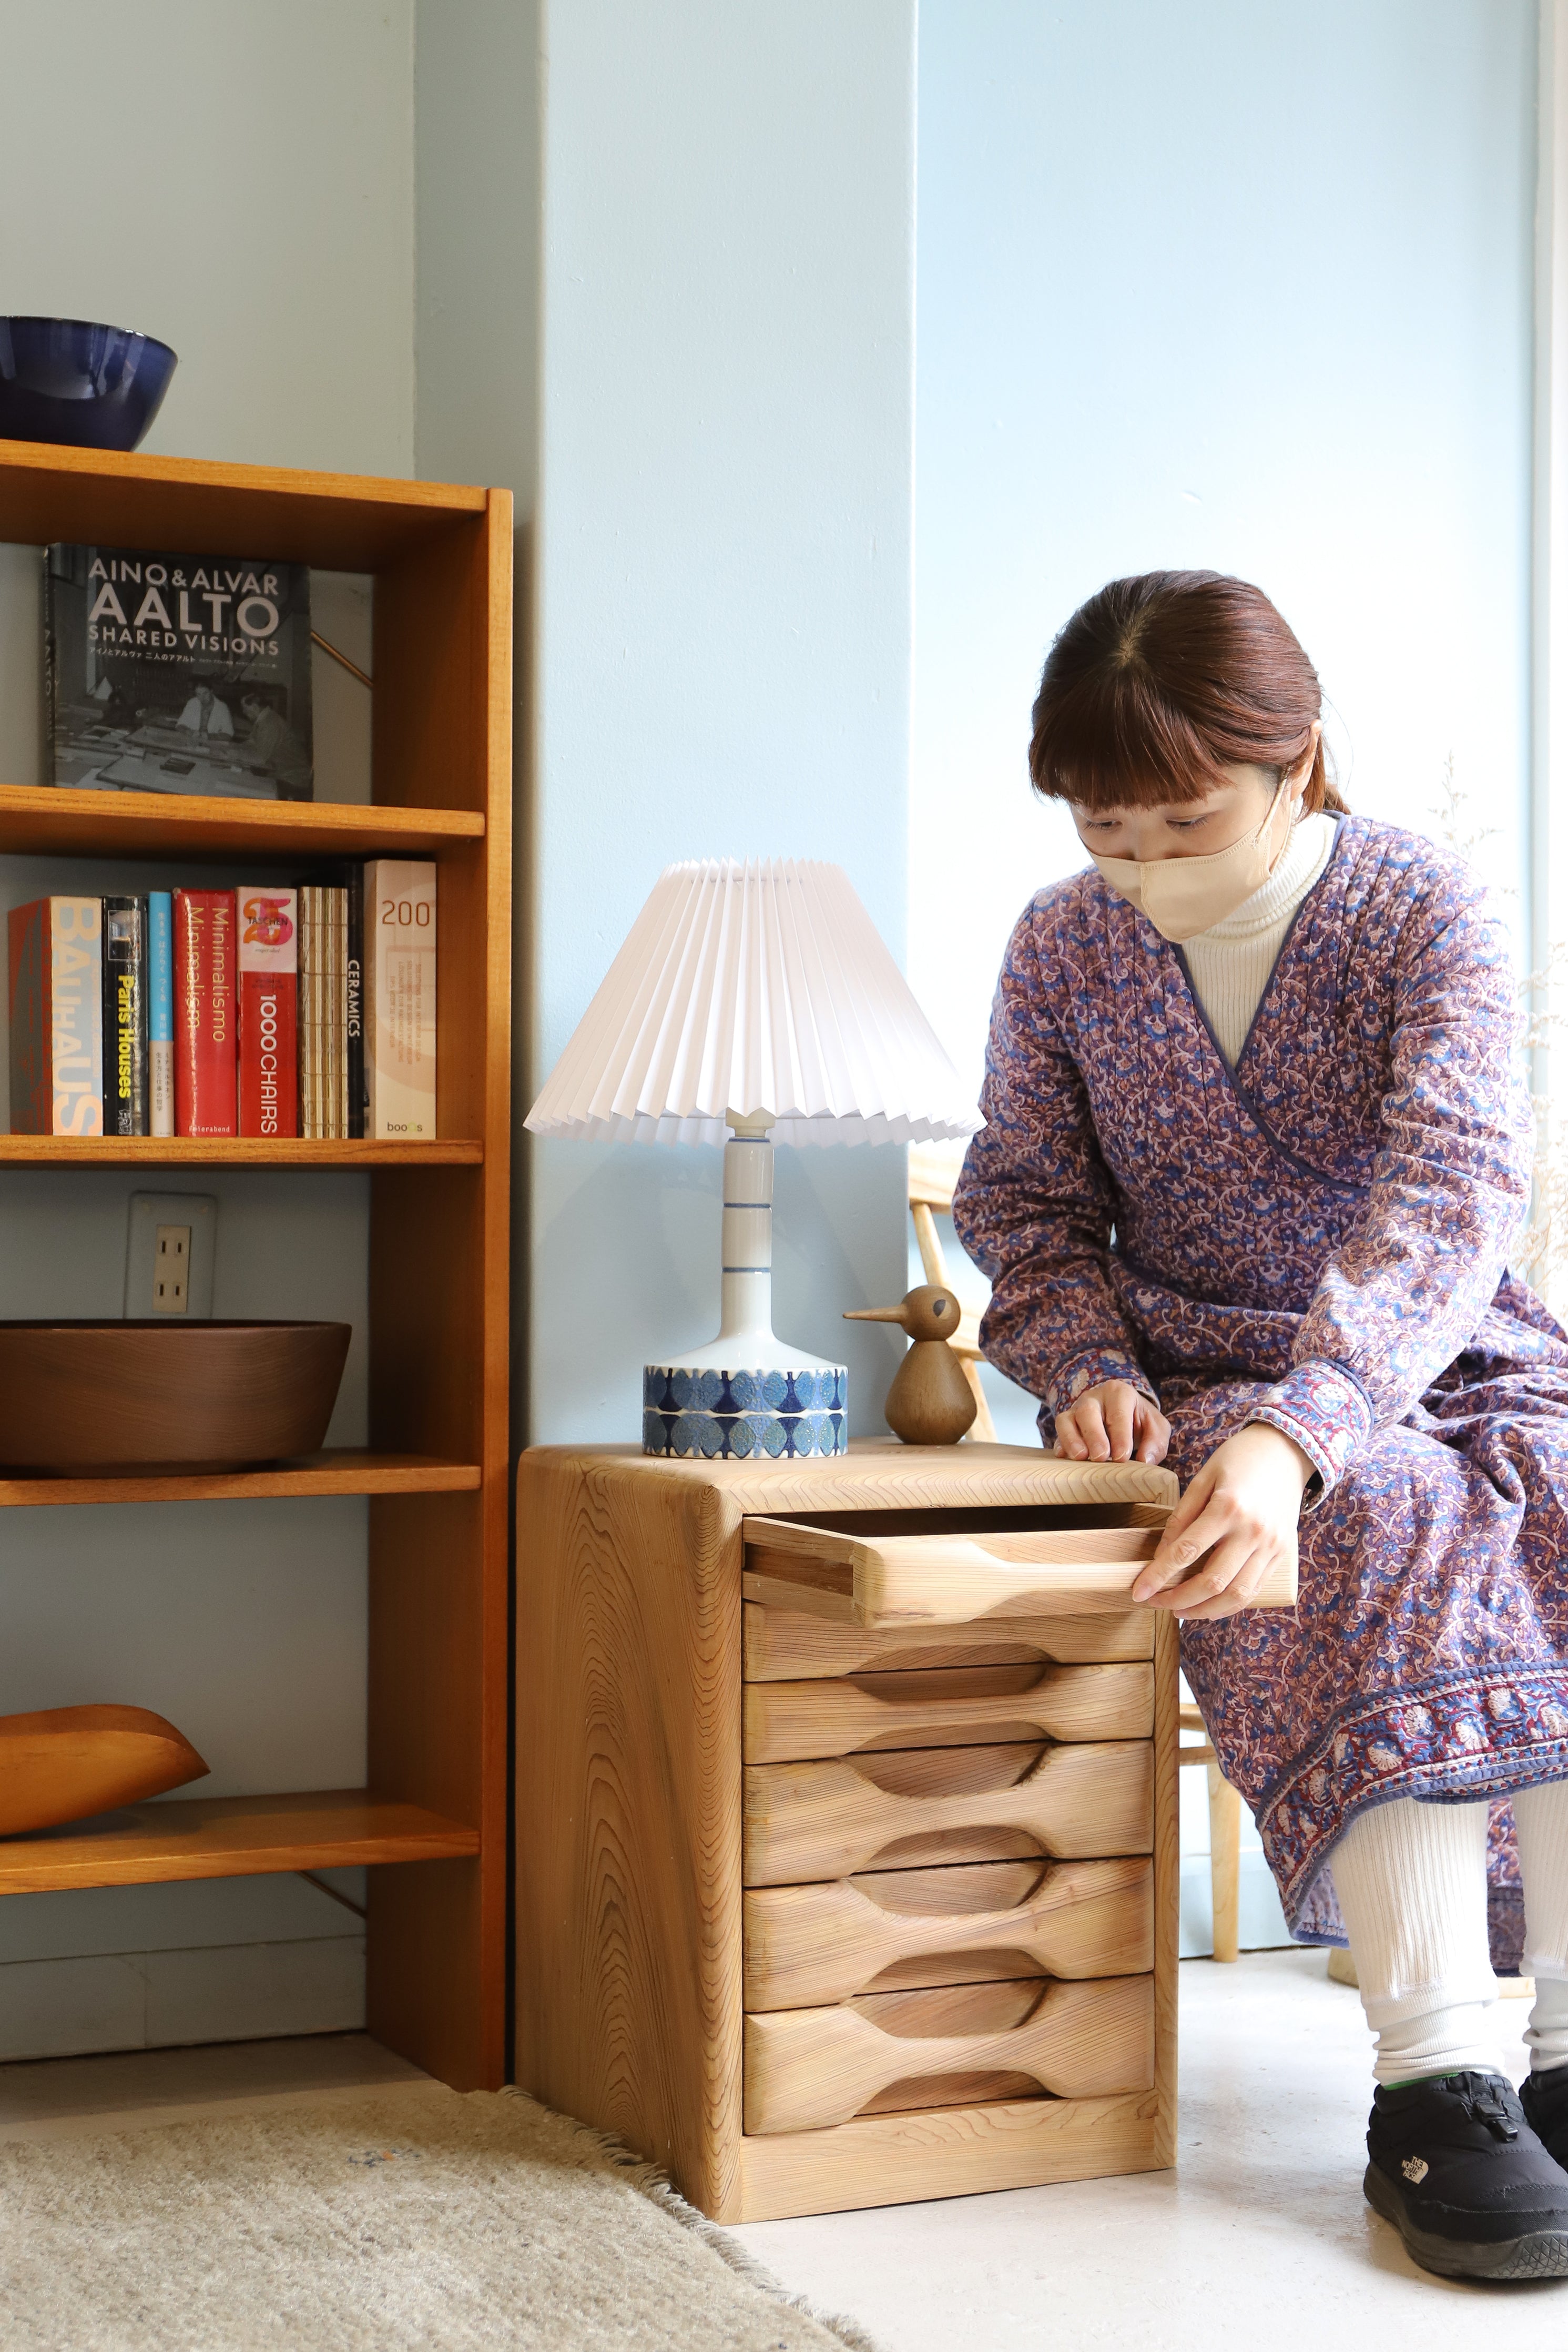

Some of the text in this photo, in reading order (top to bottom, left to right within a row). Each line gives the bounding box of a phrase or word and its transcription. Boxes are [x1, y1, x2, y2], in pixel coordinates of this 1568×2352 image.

[88, 582, 279, 637] AALTO
[89, 624, 279, 655] SHARED VISIONS
[243, 897, 293, 945] 25
[248, 916, 288, 926] TASCHEN
[382, 900, 429, 927] 200
[187, 906, 205, 1029] Minimalism
[212, 907, 229, 1042] Minimalismo
[51, 896, 103, 1136] BAUHAUS
[260, 994, 277, 1051] 1000
[348, 959, 360, 1037] CERAMICS
[118, 975, 135, 1098] Paris Houses
[260, 1054, 277, 1133] CHAIRS
[1401, 2160, 1420, 2174] NORTH
[1412, 2156, 1423, 2168] THE
